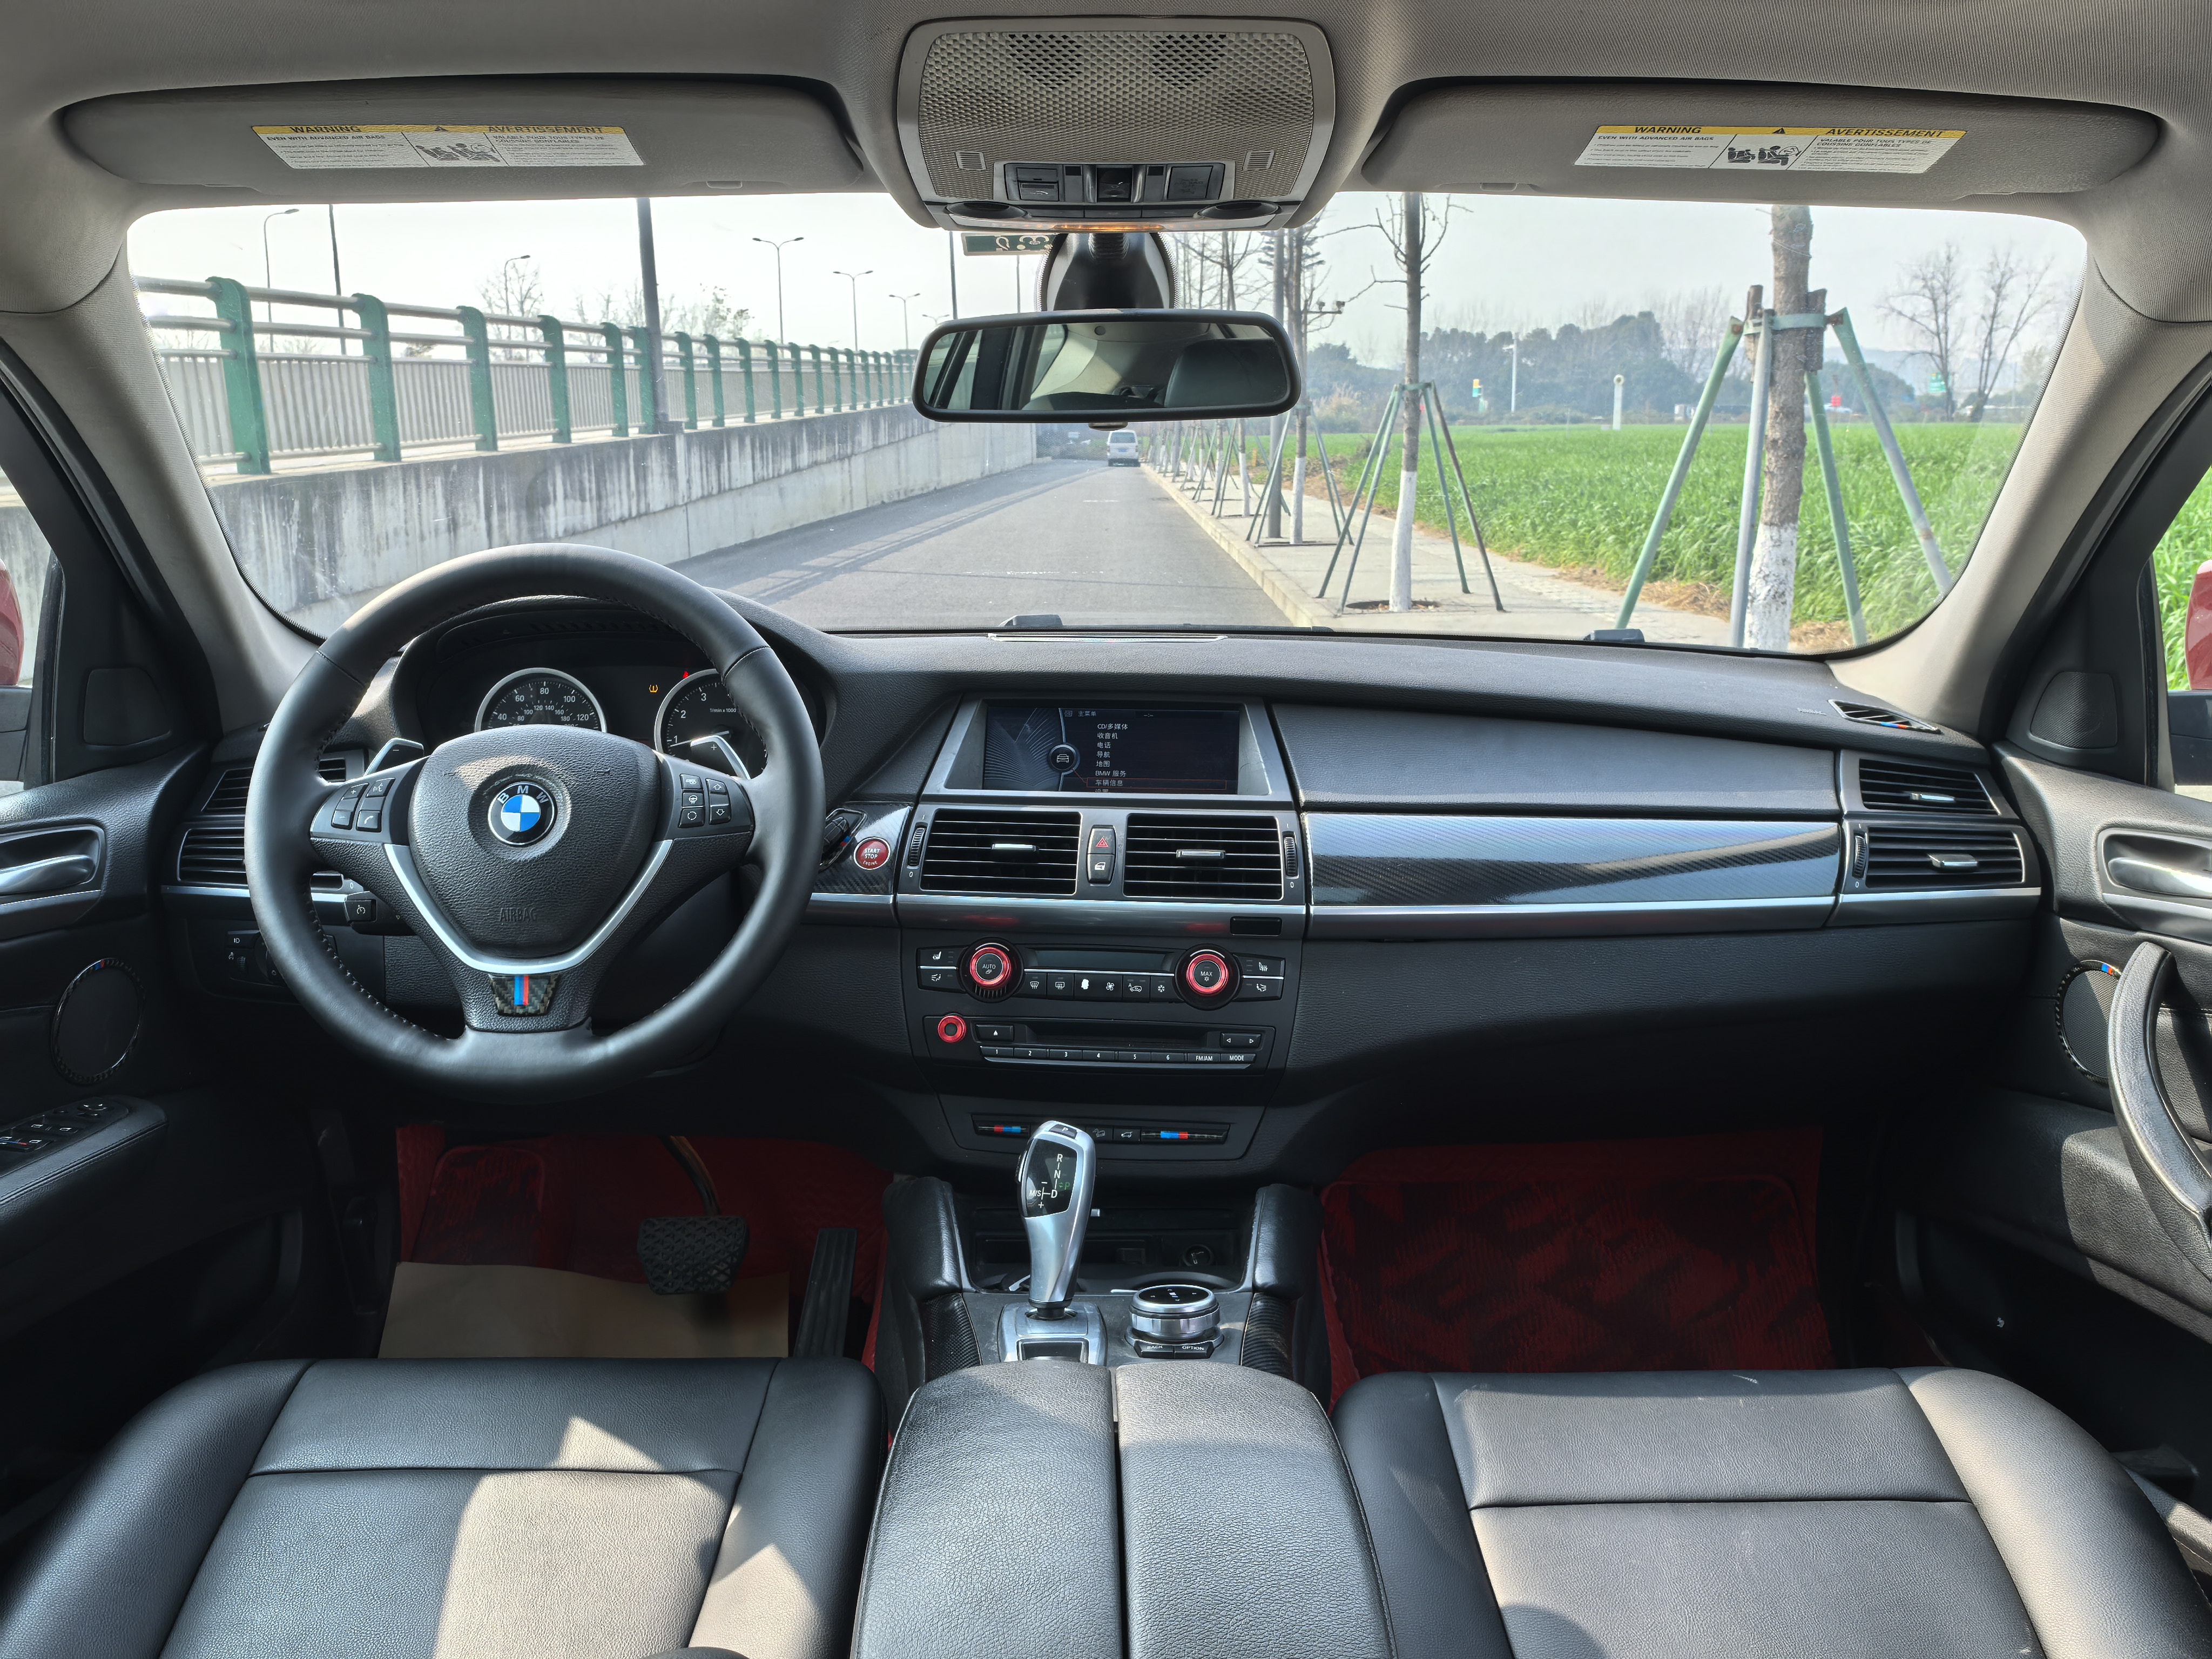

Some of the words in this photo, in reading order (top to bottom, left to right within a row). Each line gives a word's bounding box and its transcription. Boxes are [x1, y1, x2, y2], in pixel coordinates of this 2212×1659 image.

[1826, 129, 1945, 137] AVERTISSEMENT
[701, 693, 707, 701] 3
[680, 710, 686, 718] 2
[674, 735, 678, 743] 1
[497, 785, 549, 804] BMW
[499, 908, 536, 922] AIRBAG
[1056, 1154, 1063, 1162] R
[1054, 1170, 1061, 1179] N
[1051, 1189, 1058, 1198] D
